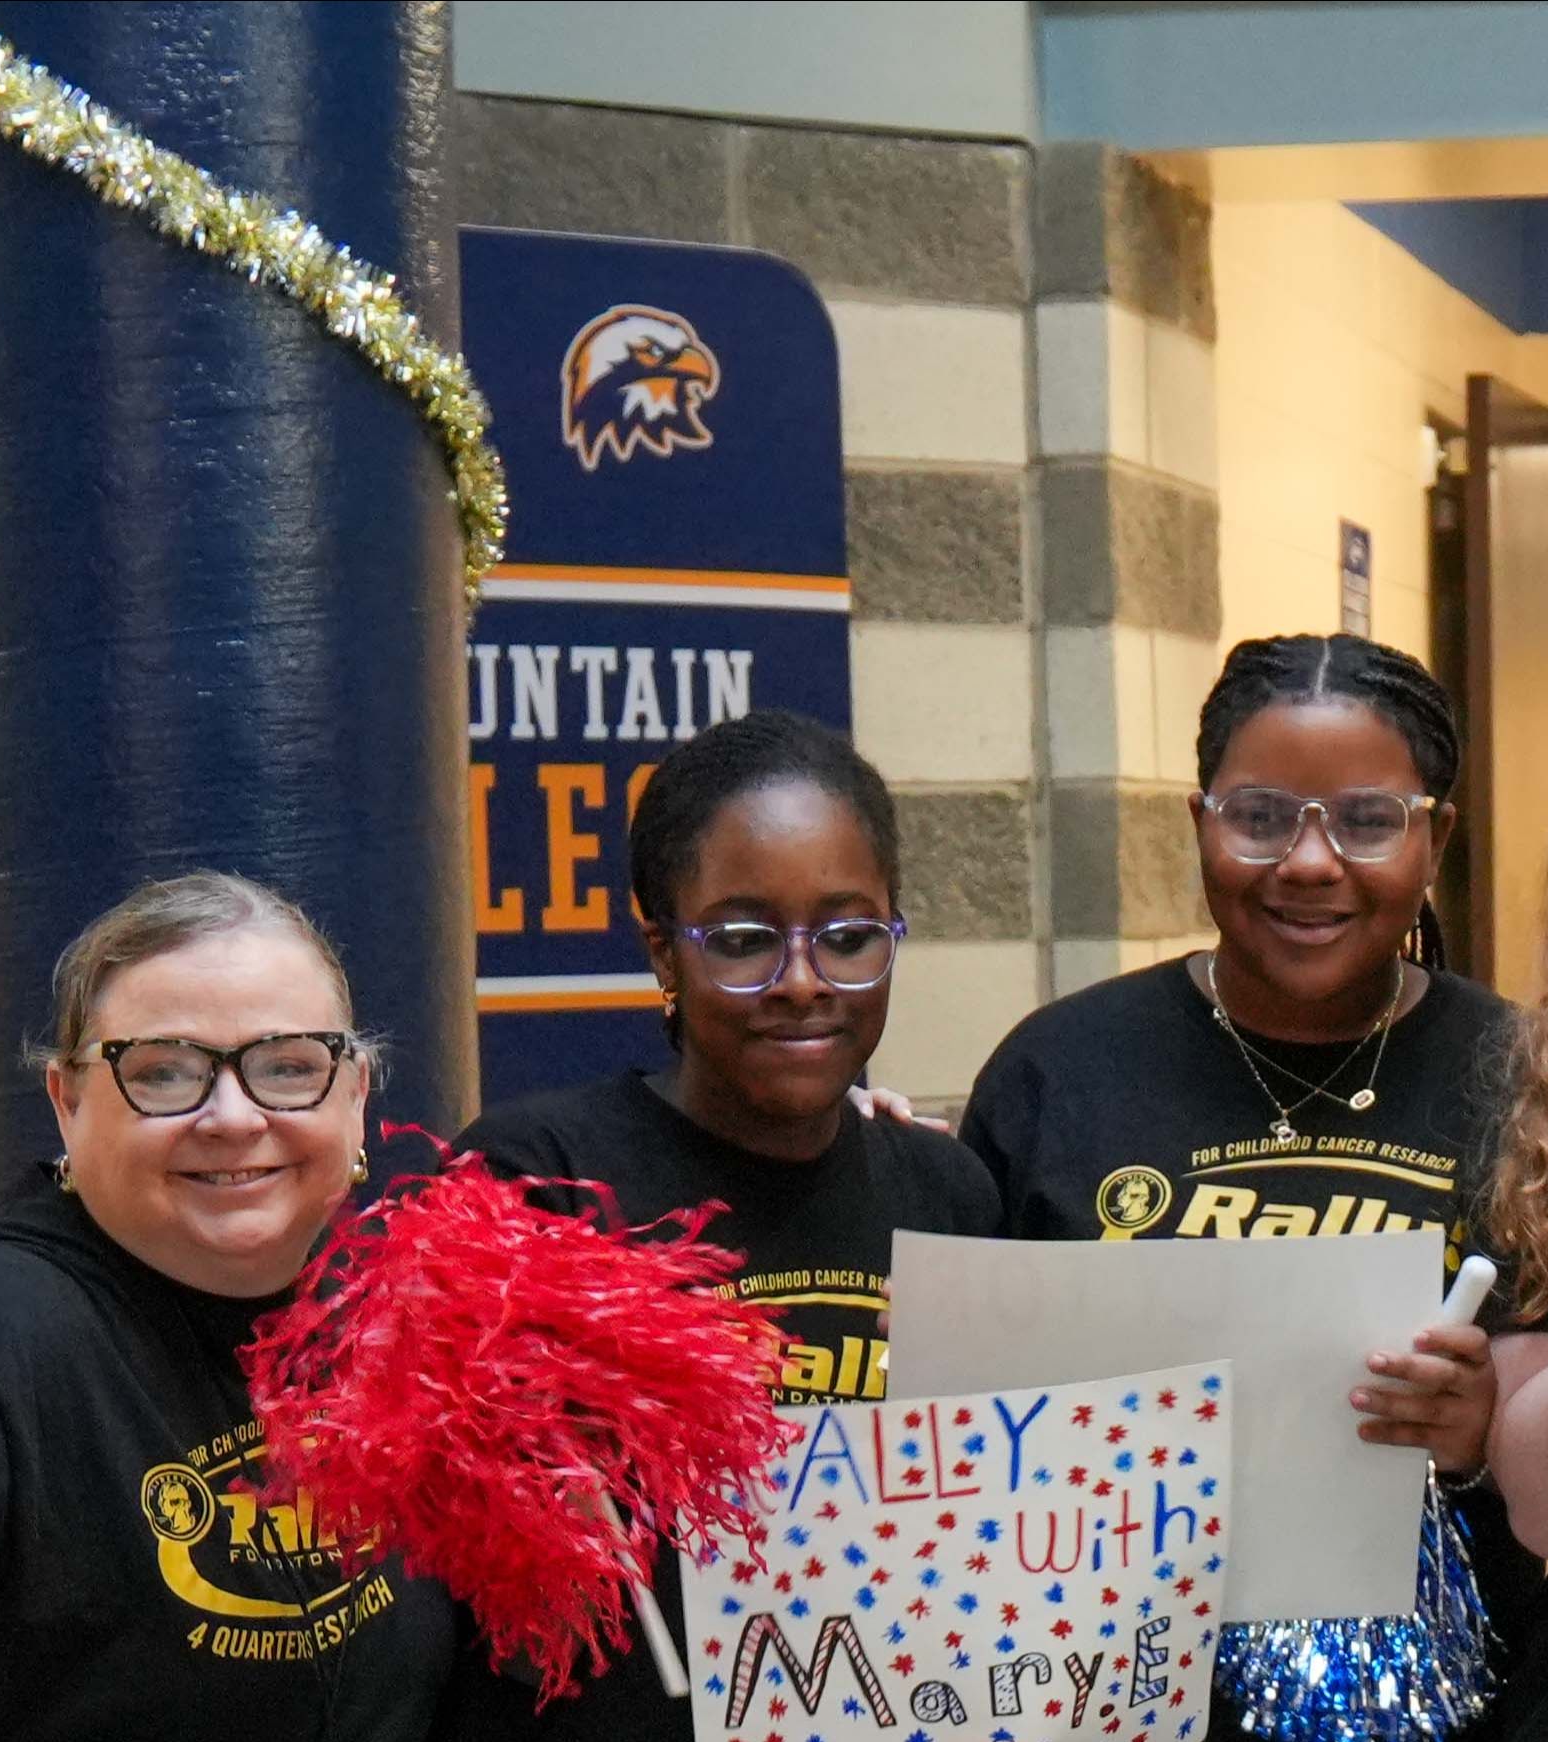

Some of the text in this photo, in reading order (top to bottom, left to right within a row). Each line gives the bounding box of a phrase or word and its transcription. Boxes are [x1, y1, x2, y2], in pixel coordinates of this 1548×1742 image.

[465, 643, 755, 746] UNTAIN
[1191, 1136, 1457, 1173] FOR CHILDHOOD CANCER RESEARCH
[739, 1270, 811, 1295] CHILDHOOD
[815, 1269, 865, 1288] CANCER
[770, 1394, 1051, 1512] ALLY
[187, 1621, 209, 1649] 4
